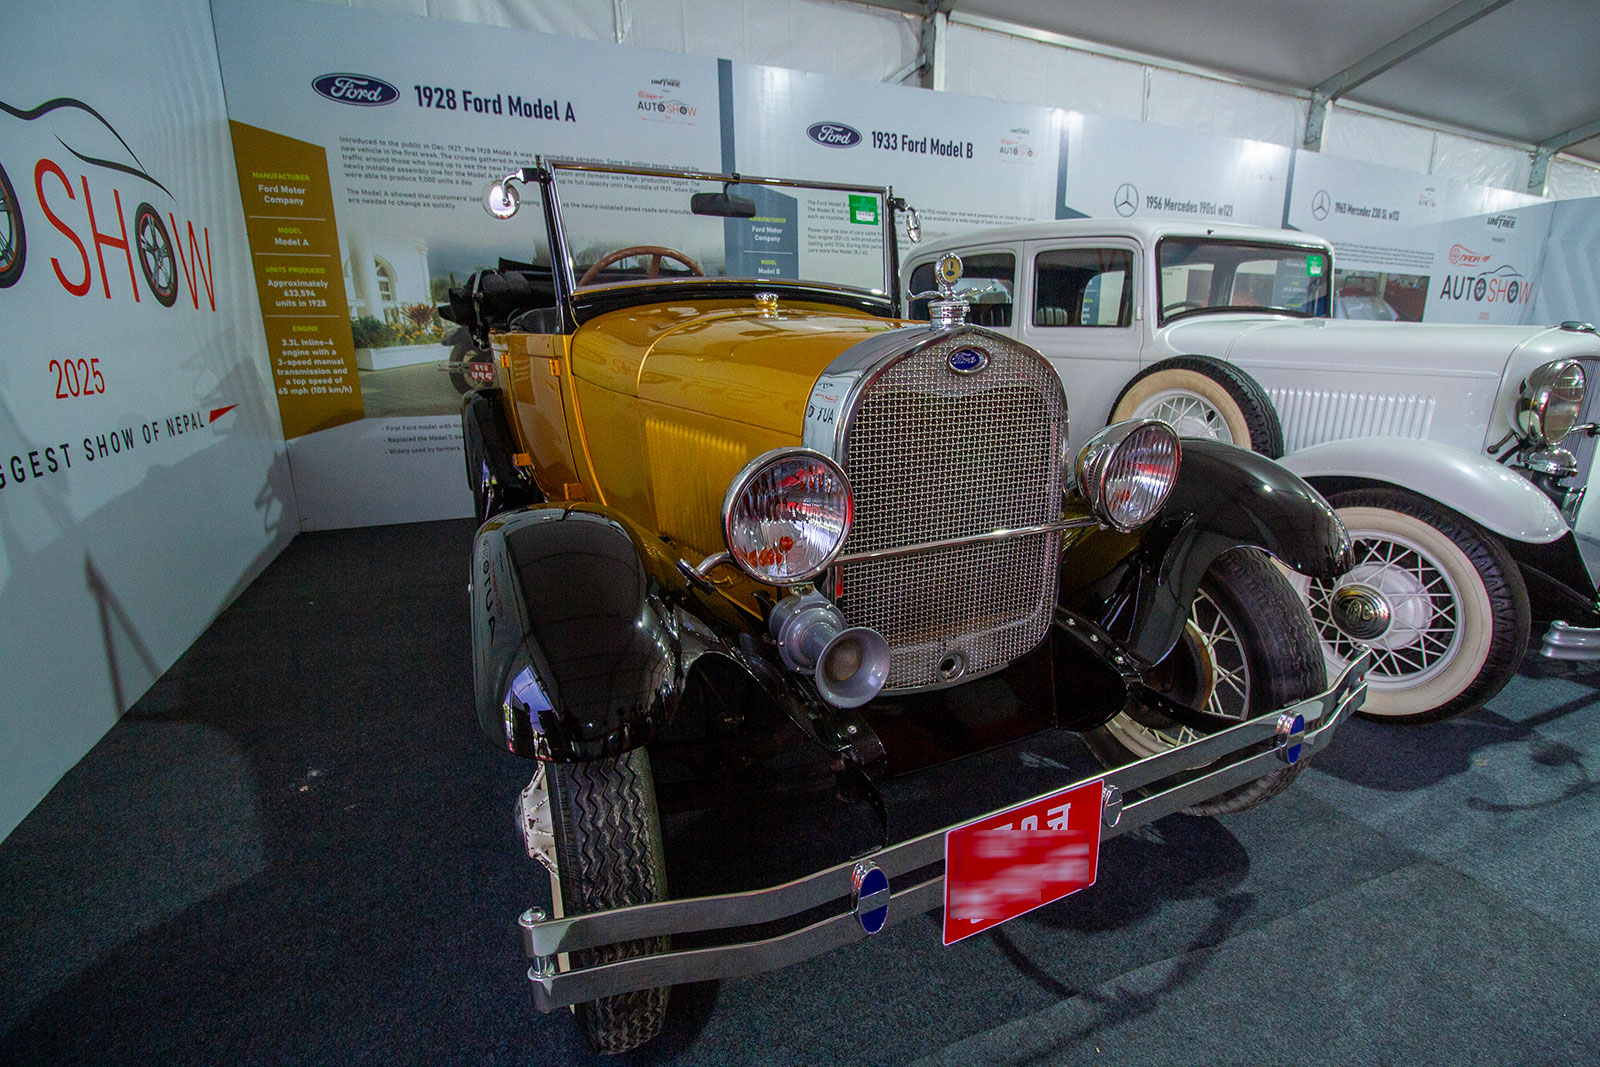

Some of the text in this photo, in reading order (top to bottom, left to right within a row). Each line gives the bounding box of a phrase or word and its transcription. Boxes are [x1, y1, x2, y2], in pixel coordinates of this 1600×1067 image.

[330, 78, 382, 102] Ford
[414, 86, 576, 122] 1928 Ford Model A
[818, 126, 851, 144] Ford
[339, 136, 378, 145] Introduced
[401, 141, 422, 151] public
[872, 132, 973, 159] 1933 Ford Model B
[358, 146, 382, 154] vehicle
[478, 155, 507, 165] gathered
[344, 163, 364, 172] newly
[398, 166, 429, 175] assembly
[252, 172, 310, 181] MANUFACTURER
[389, 174, 417, 183] produce
[258, 184, 306, 194] Ford Motor
[264, 196, 304, 206] Company
[390, 190, 417, 198] showed
[432, 193, 468, 201] customers'
[396, 199, 422, 208] change
[1146, 195, 1163, 210] 1956
[1164, 199, 1198, 214] Mercedes
[274, 238, 300, 246] Model
[755, 234, 780, 243] Company
[267, 280, 328, 289] Approximately
[284, 289, 316, 298] 633,594
[282, 349, 309, 357] engine
[49, 358, 105, 400] 2025
[293, 378, 306, 386] top
[308, 377, 333, 385] speed
[290, 387, 309, 396] mph
[310, 387, 327, 395] (105
[329, 385, 353, 394] km/h)
[83, 428, 135, 462] SHOW
[142, 421, 159, 444] OF
[166, 411, 204, 438] NEPAL
